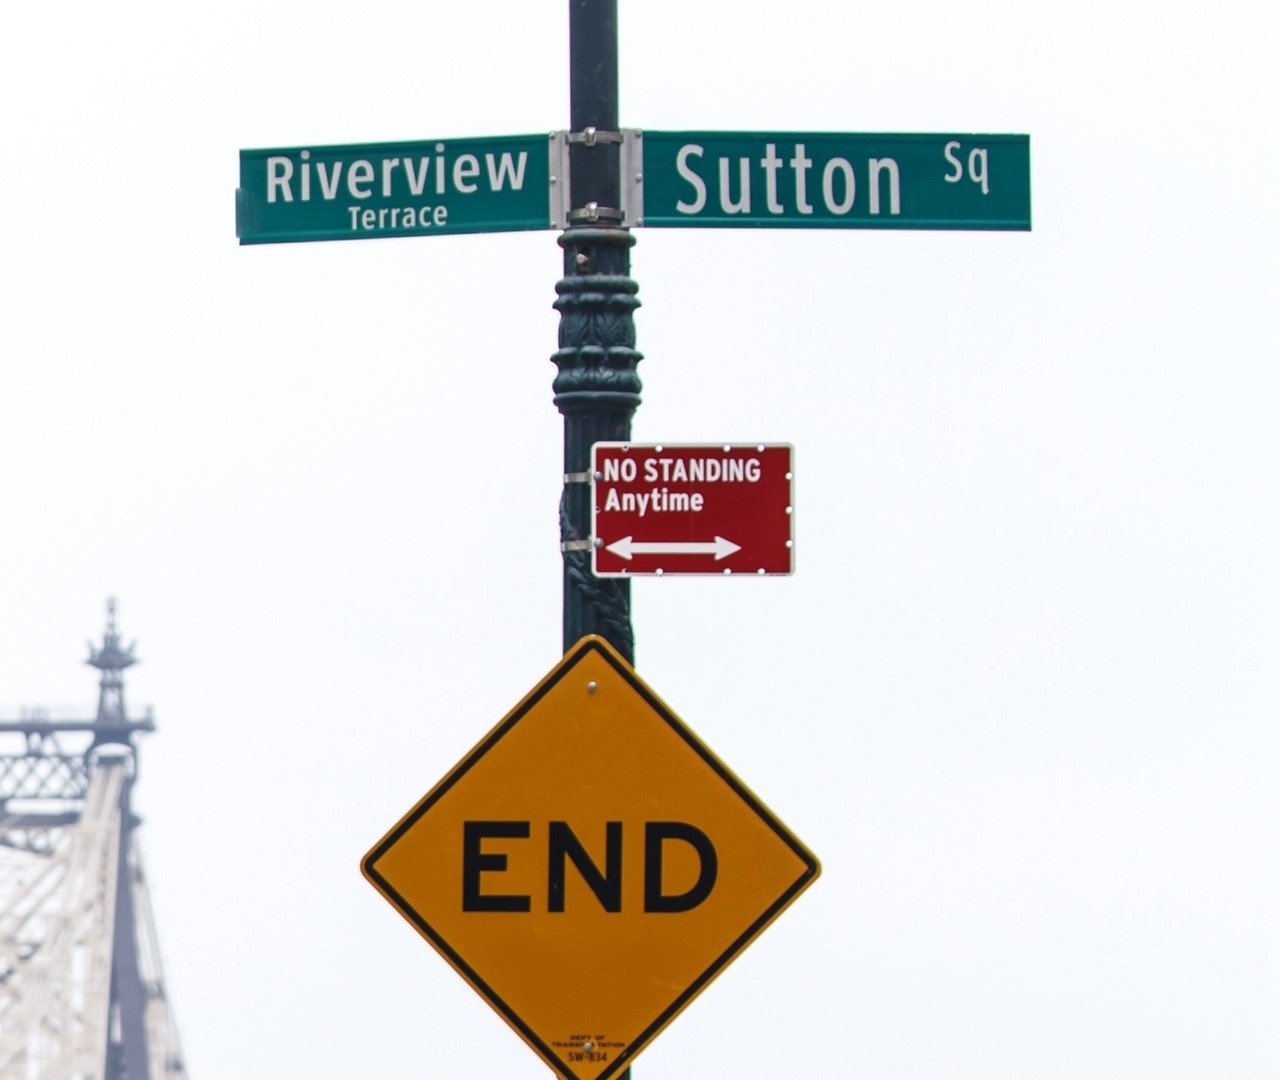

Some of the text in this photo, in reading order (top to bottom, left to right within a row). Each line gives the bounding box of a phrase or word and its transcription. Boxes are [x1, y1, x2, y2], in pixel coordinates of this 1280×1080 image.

[267, 142, 529, 204] Riverview
[676, 140, 990, 215] Sutton Sq
[348, 204, 448, 230] Terrace
[603, 458, 762, 482] NO STANDING
[604, 487, 705, 518] Anytime
[461, 820, 719, 914] END
